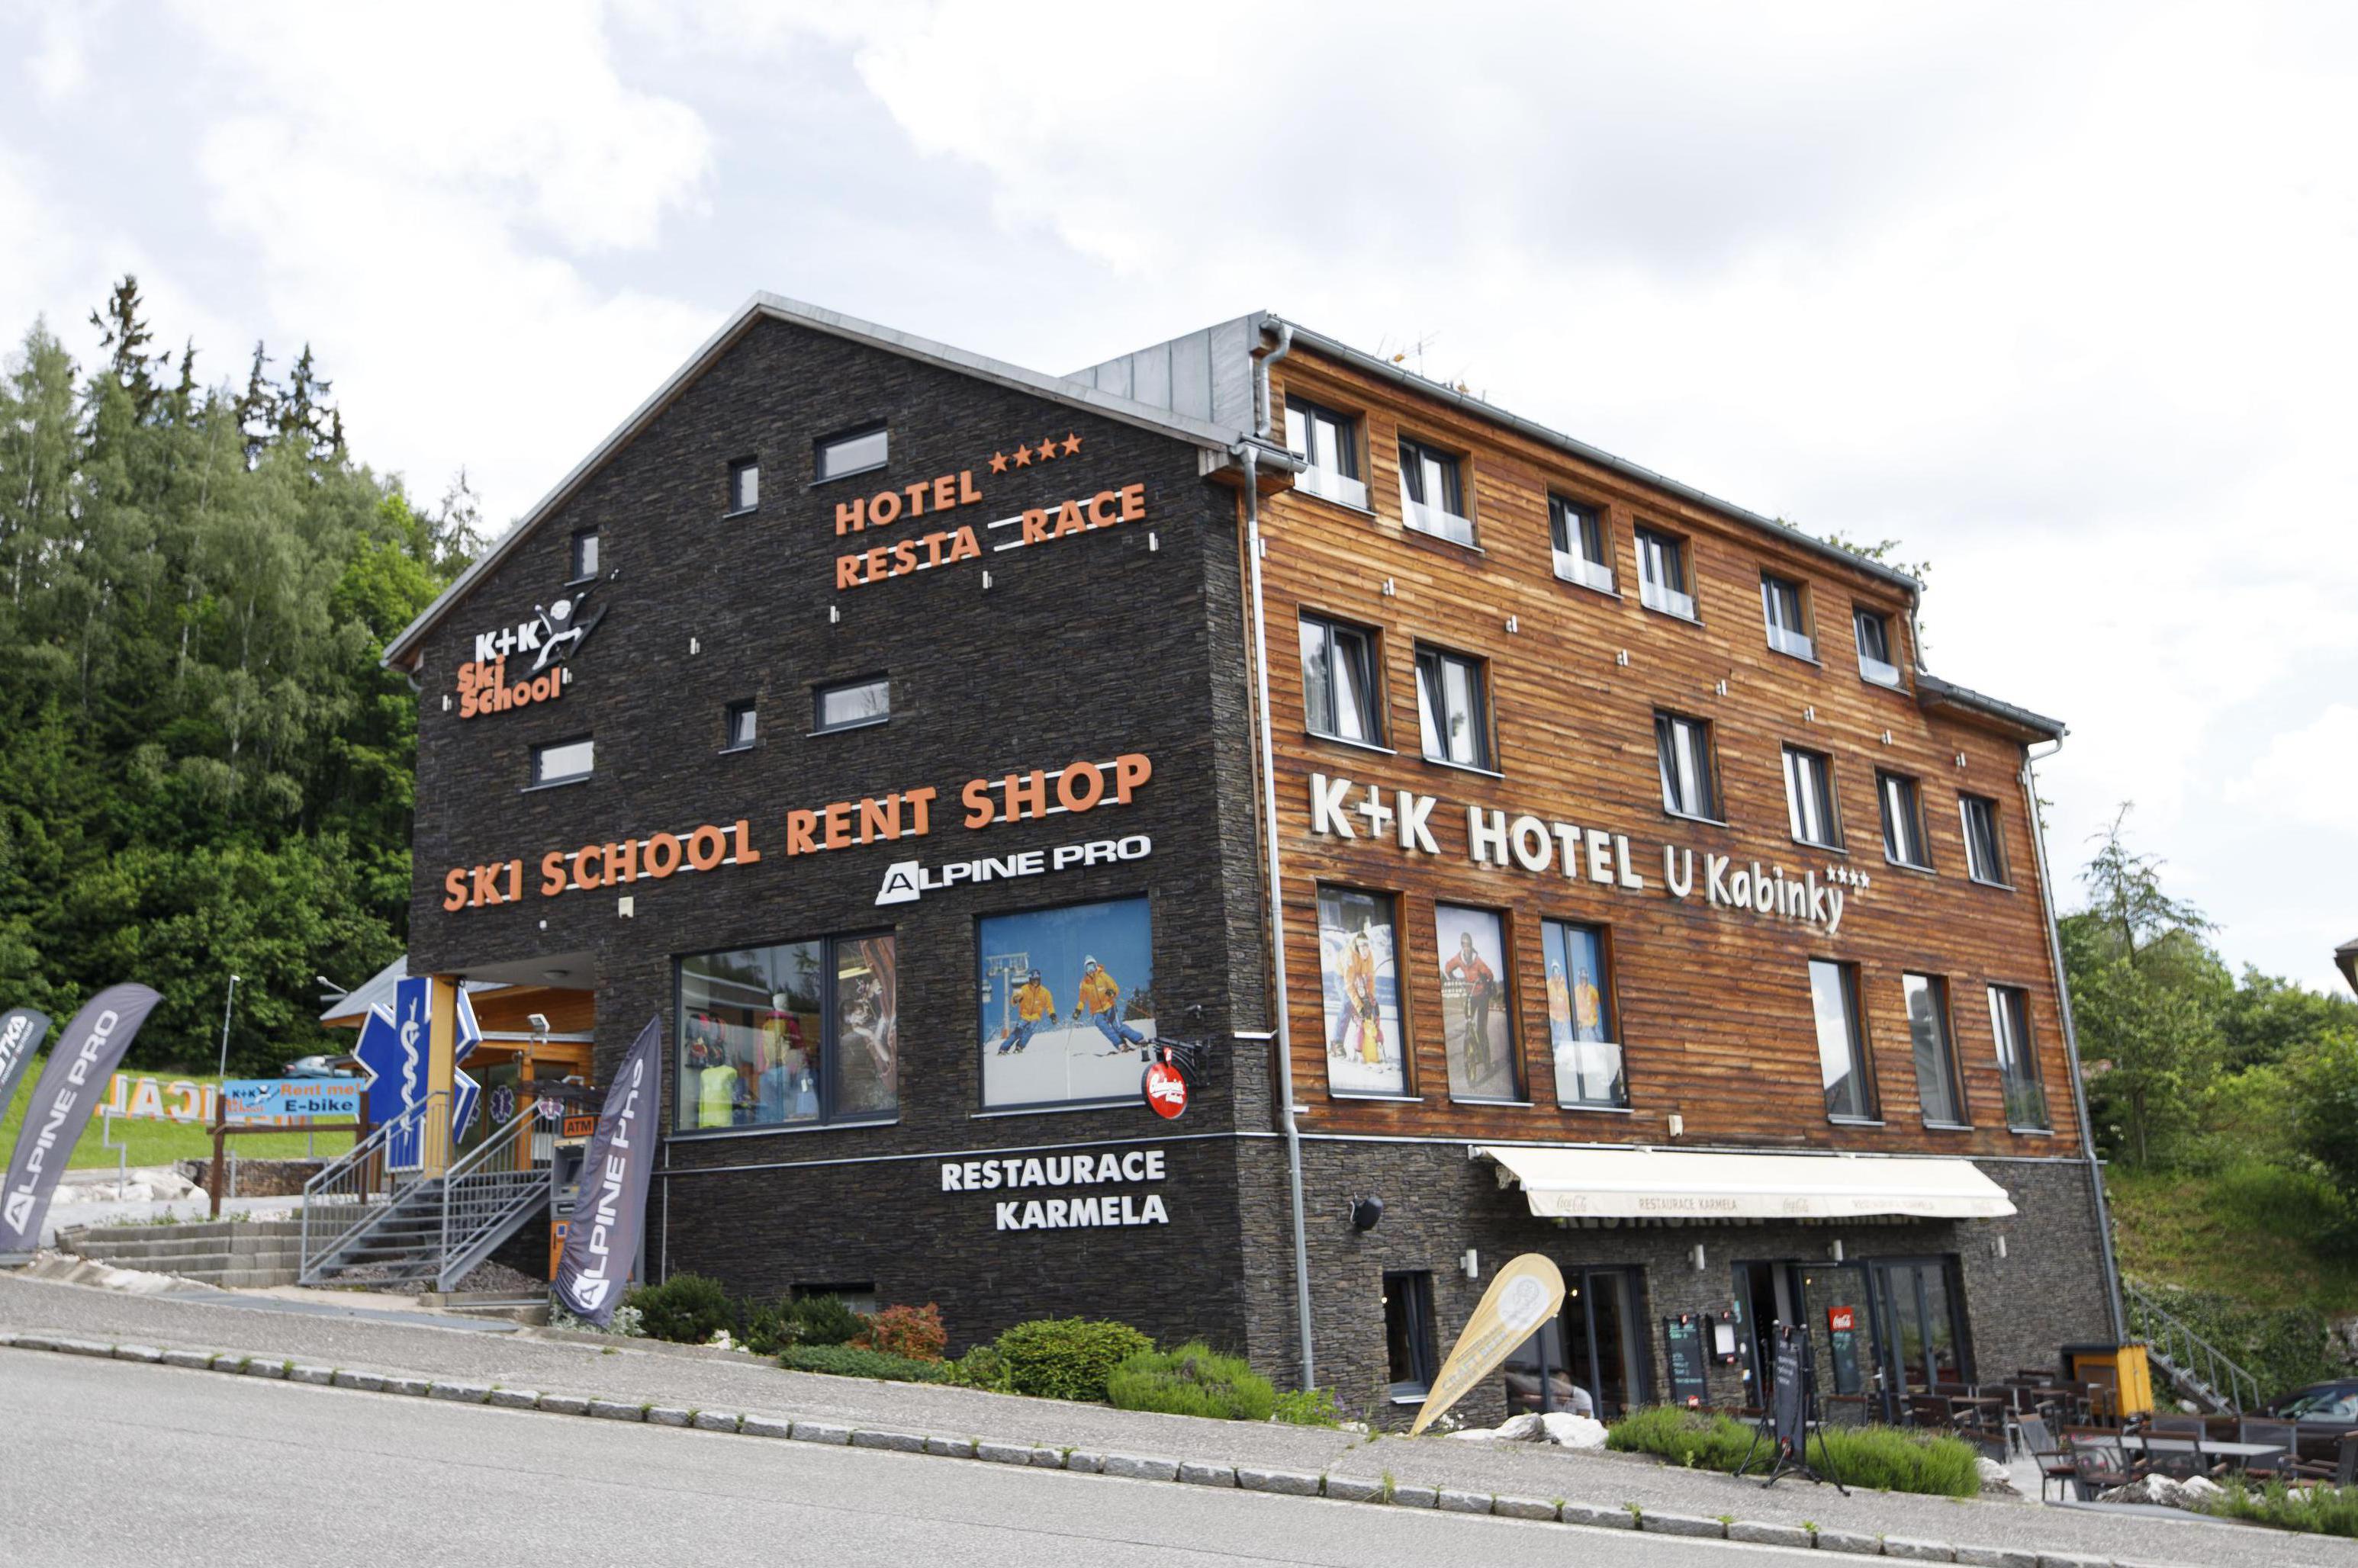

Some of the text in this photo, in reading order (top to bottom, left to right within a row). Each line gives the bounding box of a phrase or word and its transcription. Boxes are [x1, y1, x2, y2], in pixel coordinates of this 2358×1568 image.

[835, 471, 983, 535] HOTEL
[474, 619, 542, 663] K+K
[456, 653, 505, 692] Ski
[459, 667, 561, 718] School
[443, 753, 1151, 911] SKI SCHOOL RENT SHOP
[1308, 773, 1845, 934] K+K HOTEL U Kabinky
[874, 835, 1151, 905] ALPINE PRO
[0, 1016, 27, 1078] TKA
[280, 1084, 320, 1096] Rent
[285, 1099, 353, 1112] E-bike
[4, 1088, 77, 1235] ALPINE
[68, 1010, 119, 1086] PRO
[567, 1120, 592, 1133] ATM
[941, 1150, 1166, 1191] RESTAURACE
[996, 1194, 1169, 1230] KARMELA
[1639, 1198, 1694, 1210] RESTAURACE
[1699, 1198, 1738, 1211] KARMELA
[571, 1156, 626, 1310] ALPINE
